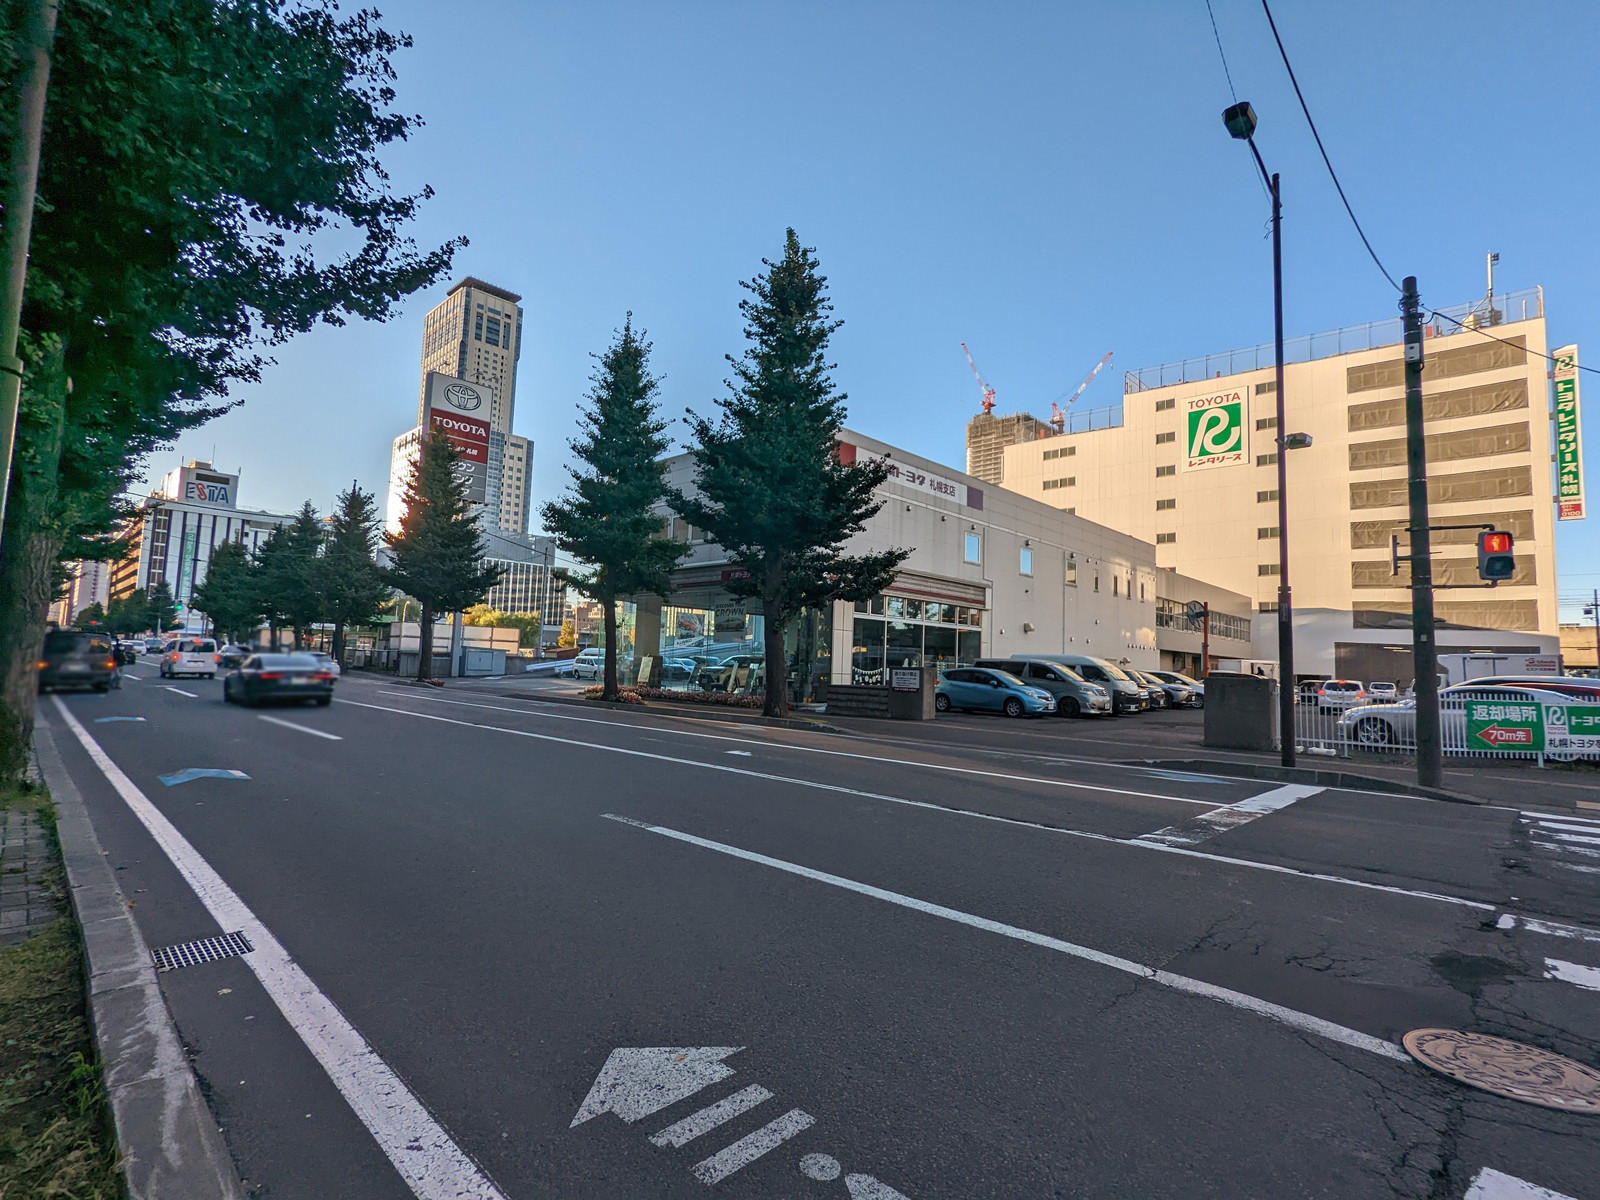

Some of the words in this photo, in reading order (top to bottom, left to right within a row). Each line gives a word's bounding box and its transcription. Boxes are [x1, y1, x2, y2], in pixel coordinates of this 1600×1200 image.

[1188, 392, 1240, 409] TOYOTA
[432, 416, 487, 437] TOYOTA
[1557, 382, 1579, 494] トヨタレンタリース札幌
[1188, 453, 1242, 467] レンタリース
[185, 481, 229, 503] ESTA
[929, 479, 956, 497] 札幌支店
[1472, 705, 1537, 722] 返却場所
[1488, 730, 1527, 741] 70m先
